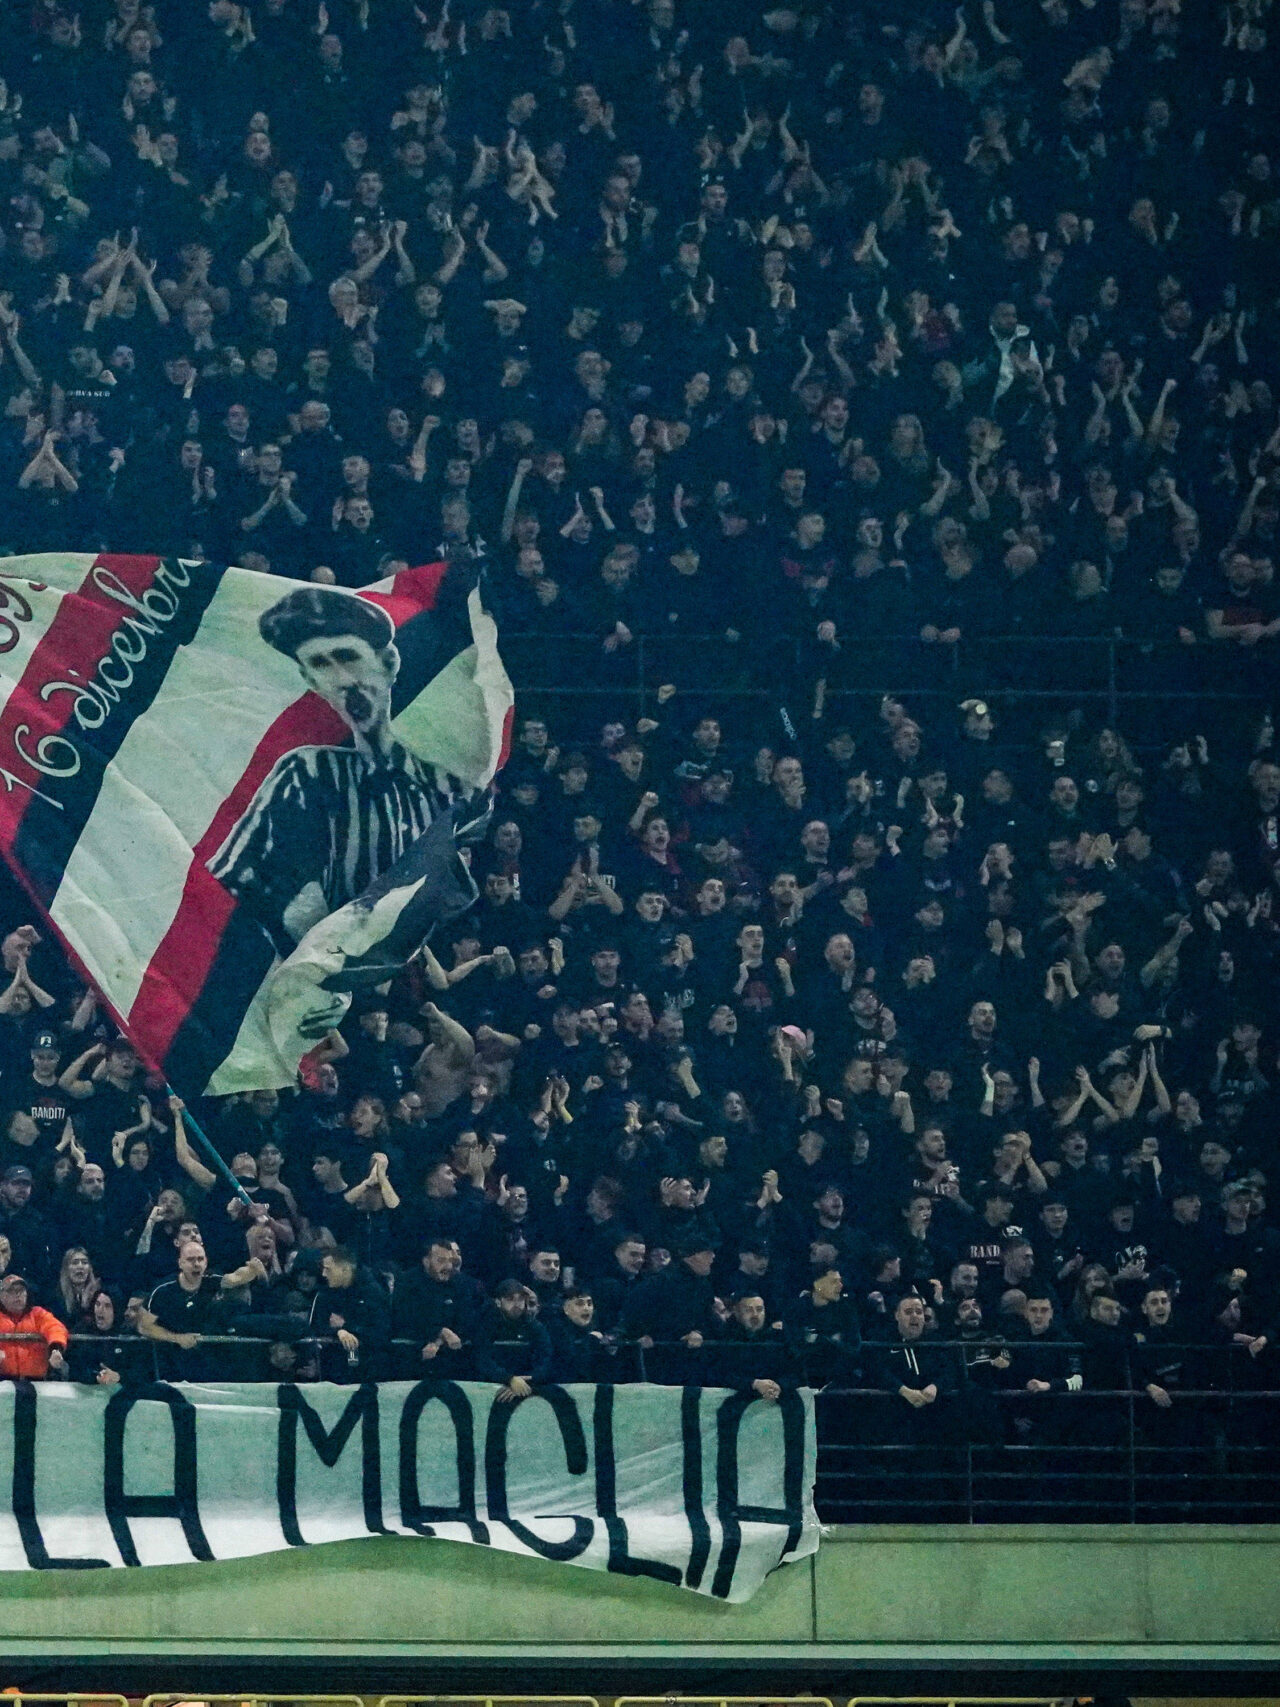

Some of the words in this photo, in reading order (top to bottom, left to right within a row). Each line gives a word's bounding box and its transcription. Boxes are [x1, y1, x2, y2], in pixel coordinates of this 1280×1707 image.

[31, 1106, 65, 1120] BANDITI
[12, 1378, 217, 1570] LA
[276, 1379, 805, 1600] MAGLIA
